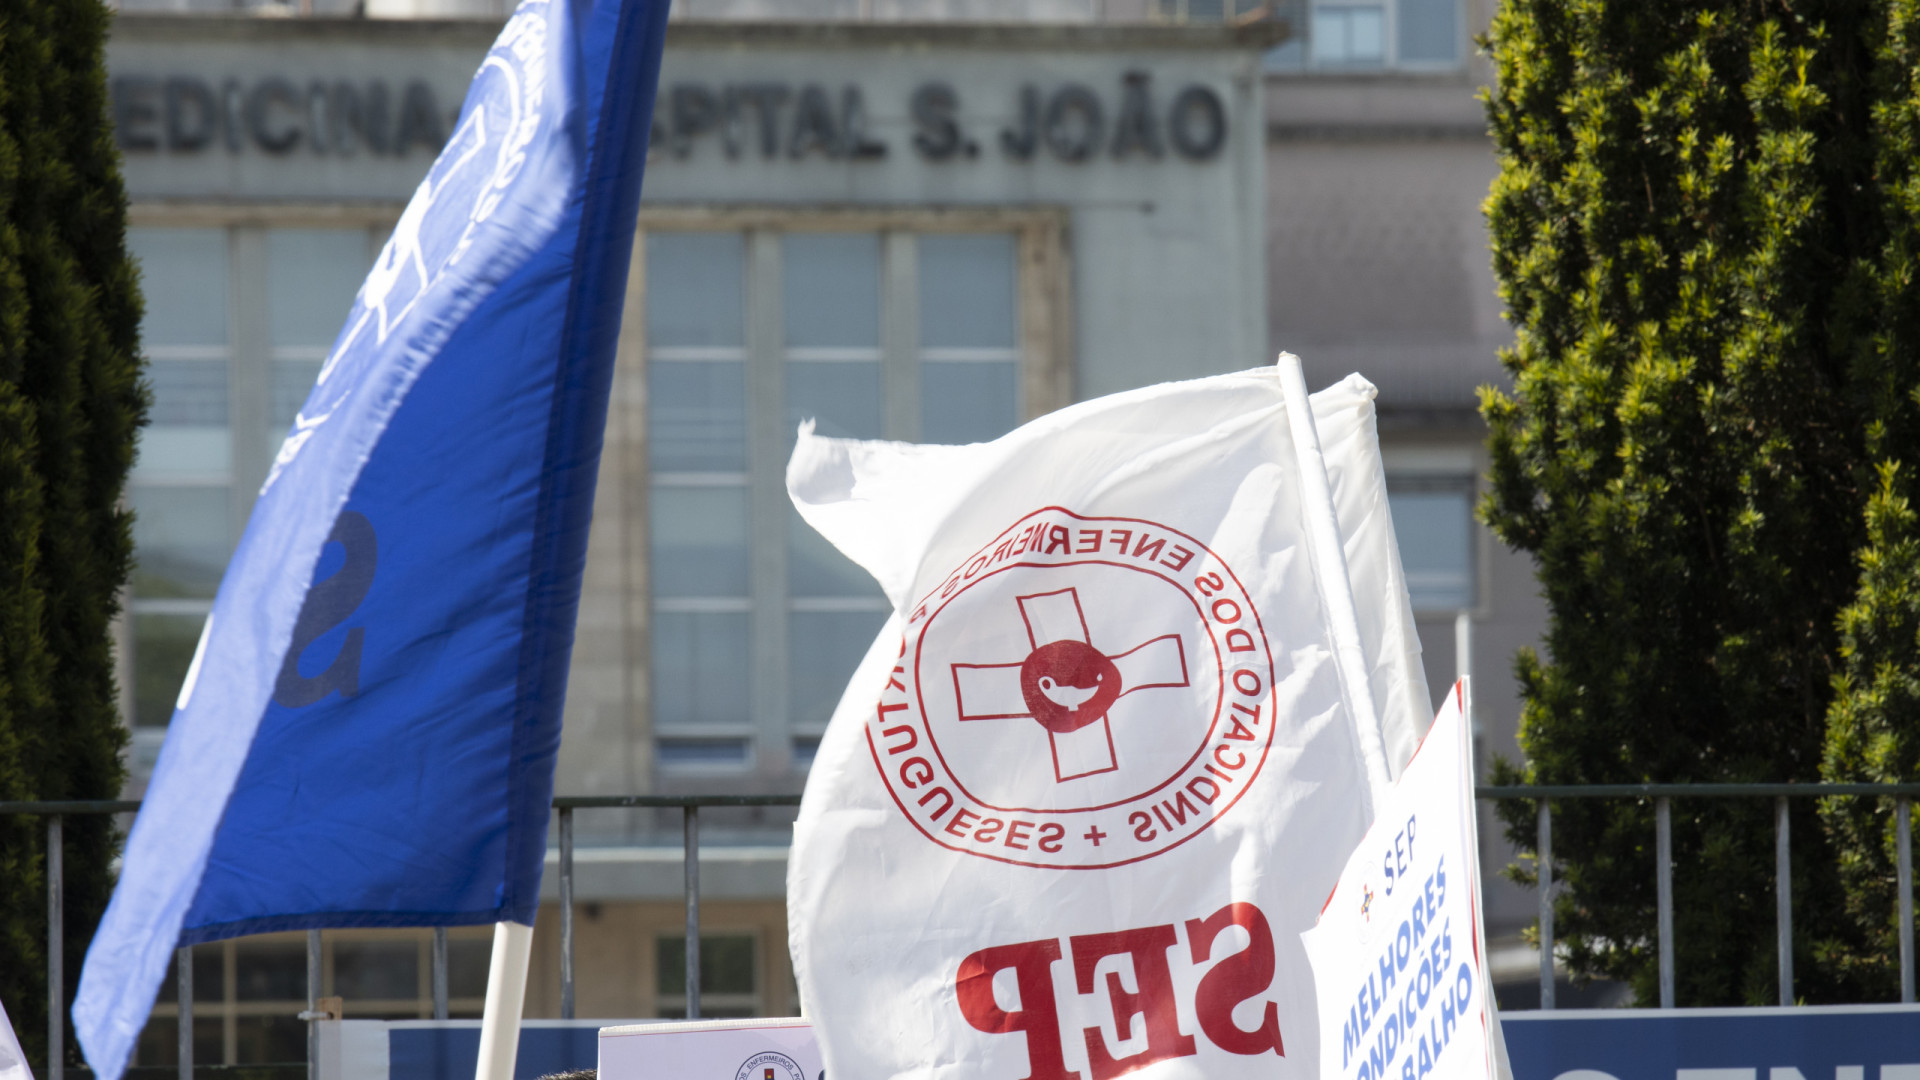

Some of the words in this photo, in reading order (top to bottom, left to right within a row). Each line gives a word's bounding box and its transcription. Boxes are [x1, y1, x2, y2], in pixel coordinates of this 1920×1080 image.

[112, 75, 446, 158] EDICINA
[650, 82, 887, 161] PITAL
[911, 80, 981, 162] S.
[1000, 70, 1229, 164] JOÃO
[1383, 814, 1416, 896] SEP
[1343, 853, 1446, 1071] MELHORES
[746, 1055, 794, 1071] ENFERMEIROS
[1400, 962, 1472, 1080] BALHO
